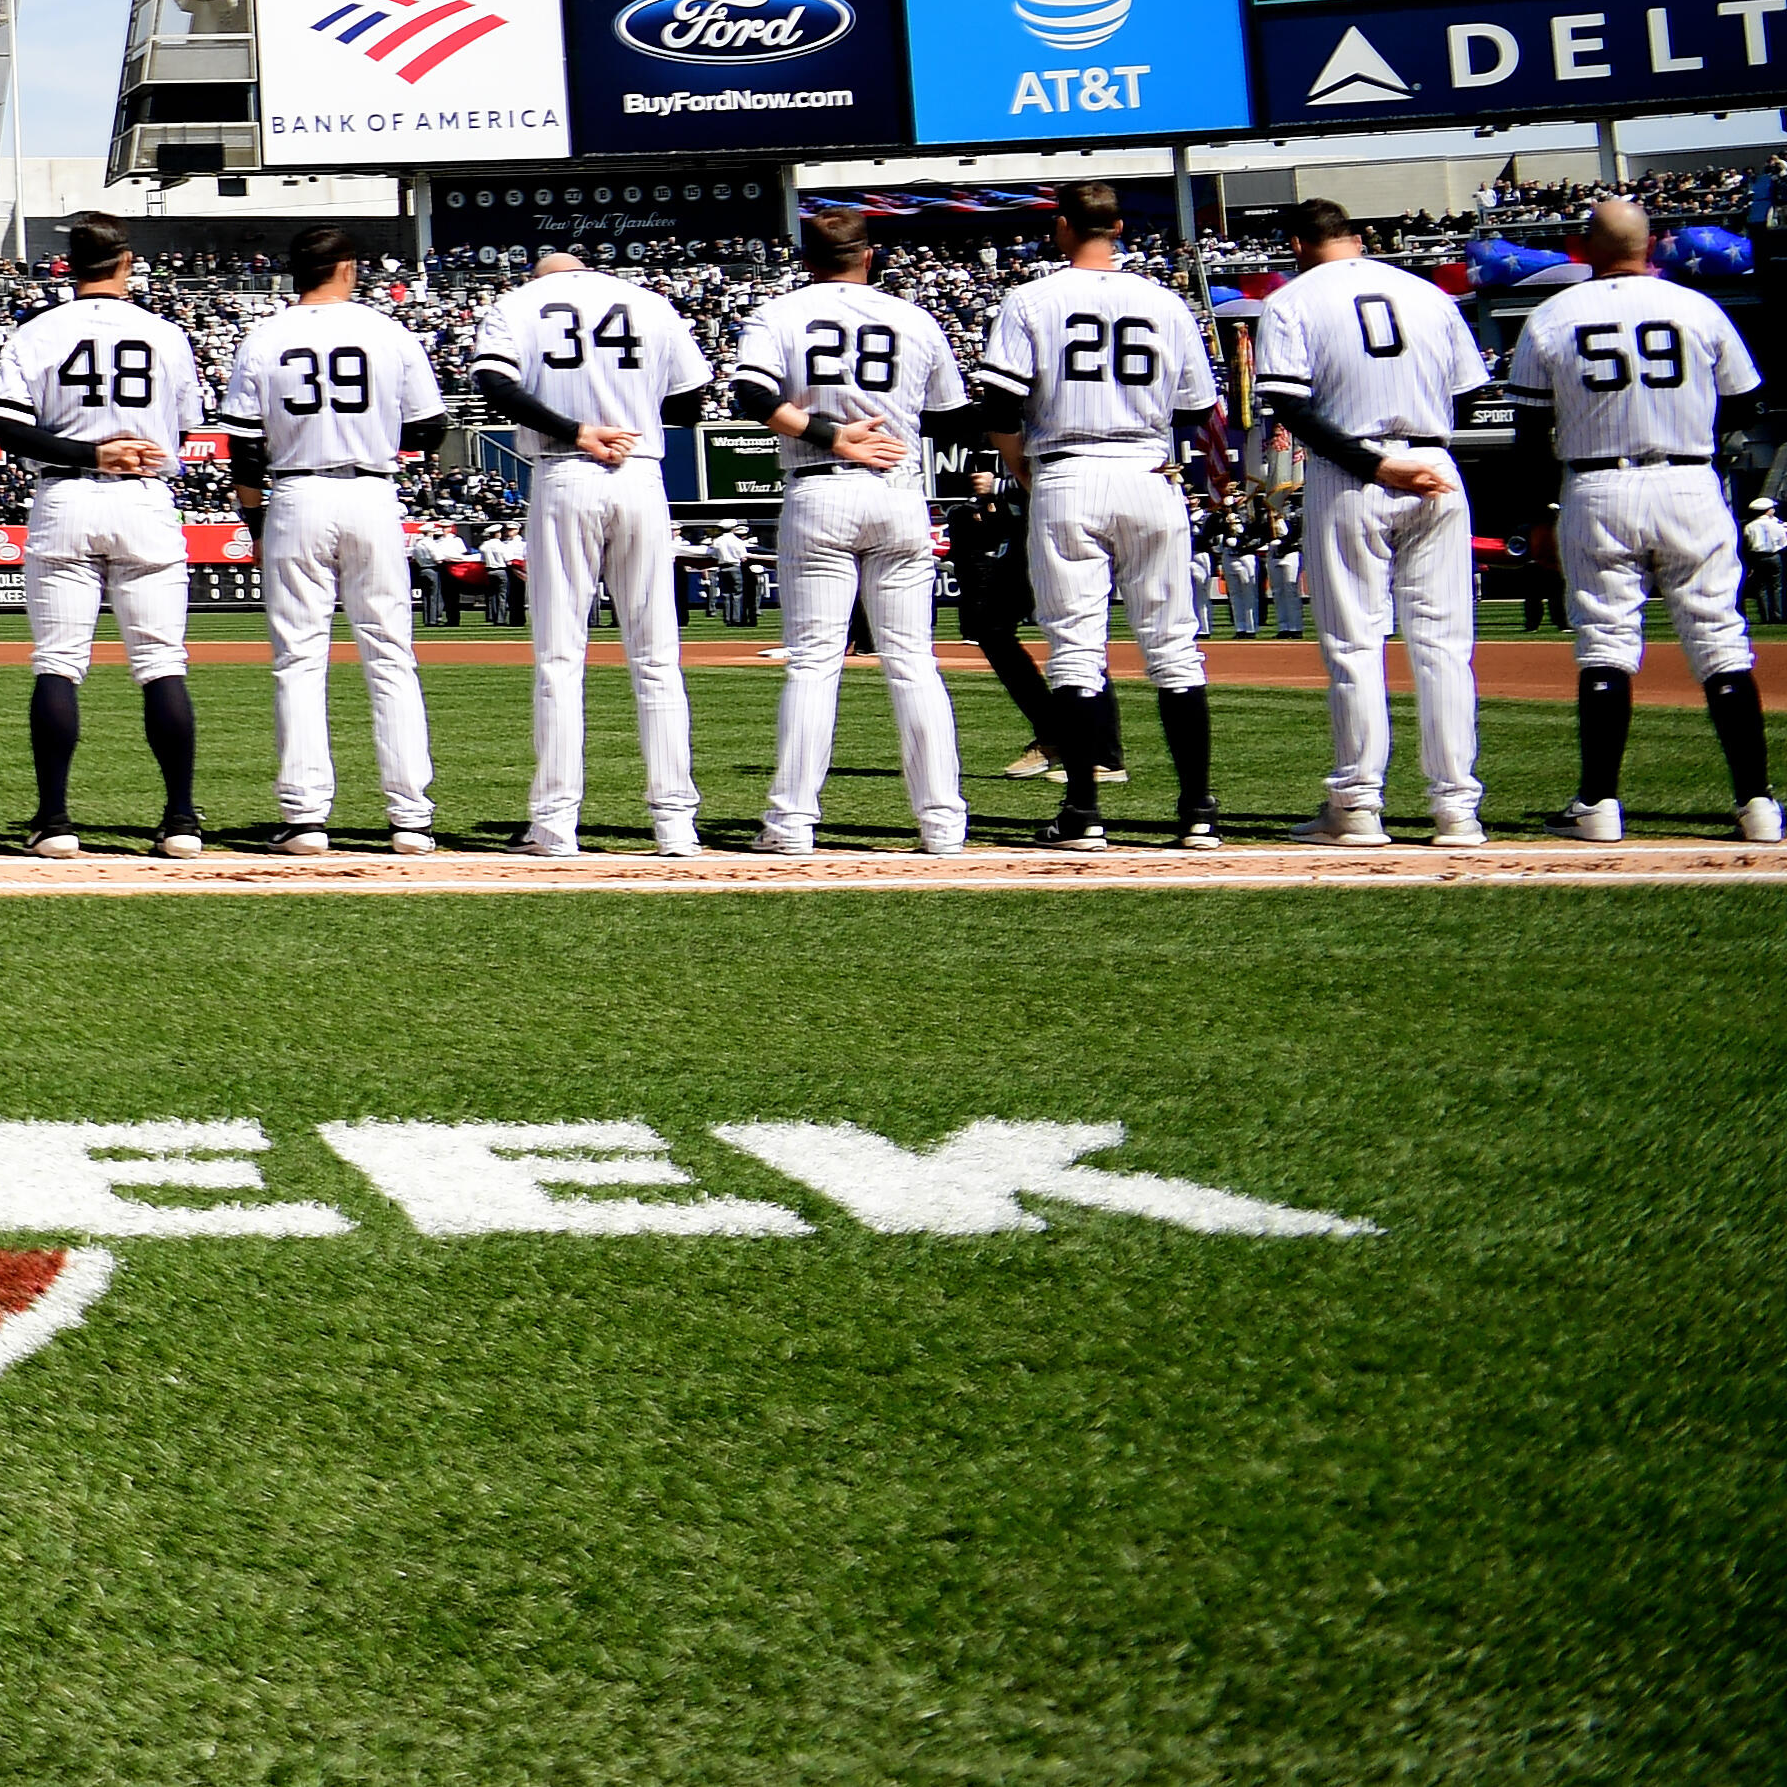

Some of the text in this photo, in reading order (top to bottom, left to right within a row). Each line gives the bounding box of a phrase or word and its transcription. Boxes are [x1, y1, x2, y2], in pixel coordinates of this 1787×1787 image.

[271, 108, 560, 135] BANK OF AMERICA
[623, 87, 854, 115] BuyFordNow.com
[1010, 65, 1151, 116] AT&T
[533, 211, 677, 238] New York Yankees
[539, 301, 644, 371] 34
[803, 319, 899, 394] 28
[1063, 312, 1161, 388] 26
[1352, 293, 1406, 360] 0
[1573, 320, 1686, 393] 59
[55, 339, 154, 409] 48
[278, 345, 371, 417] 39
